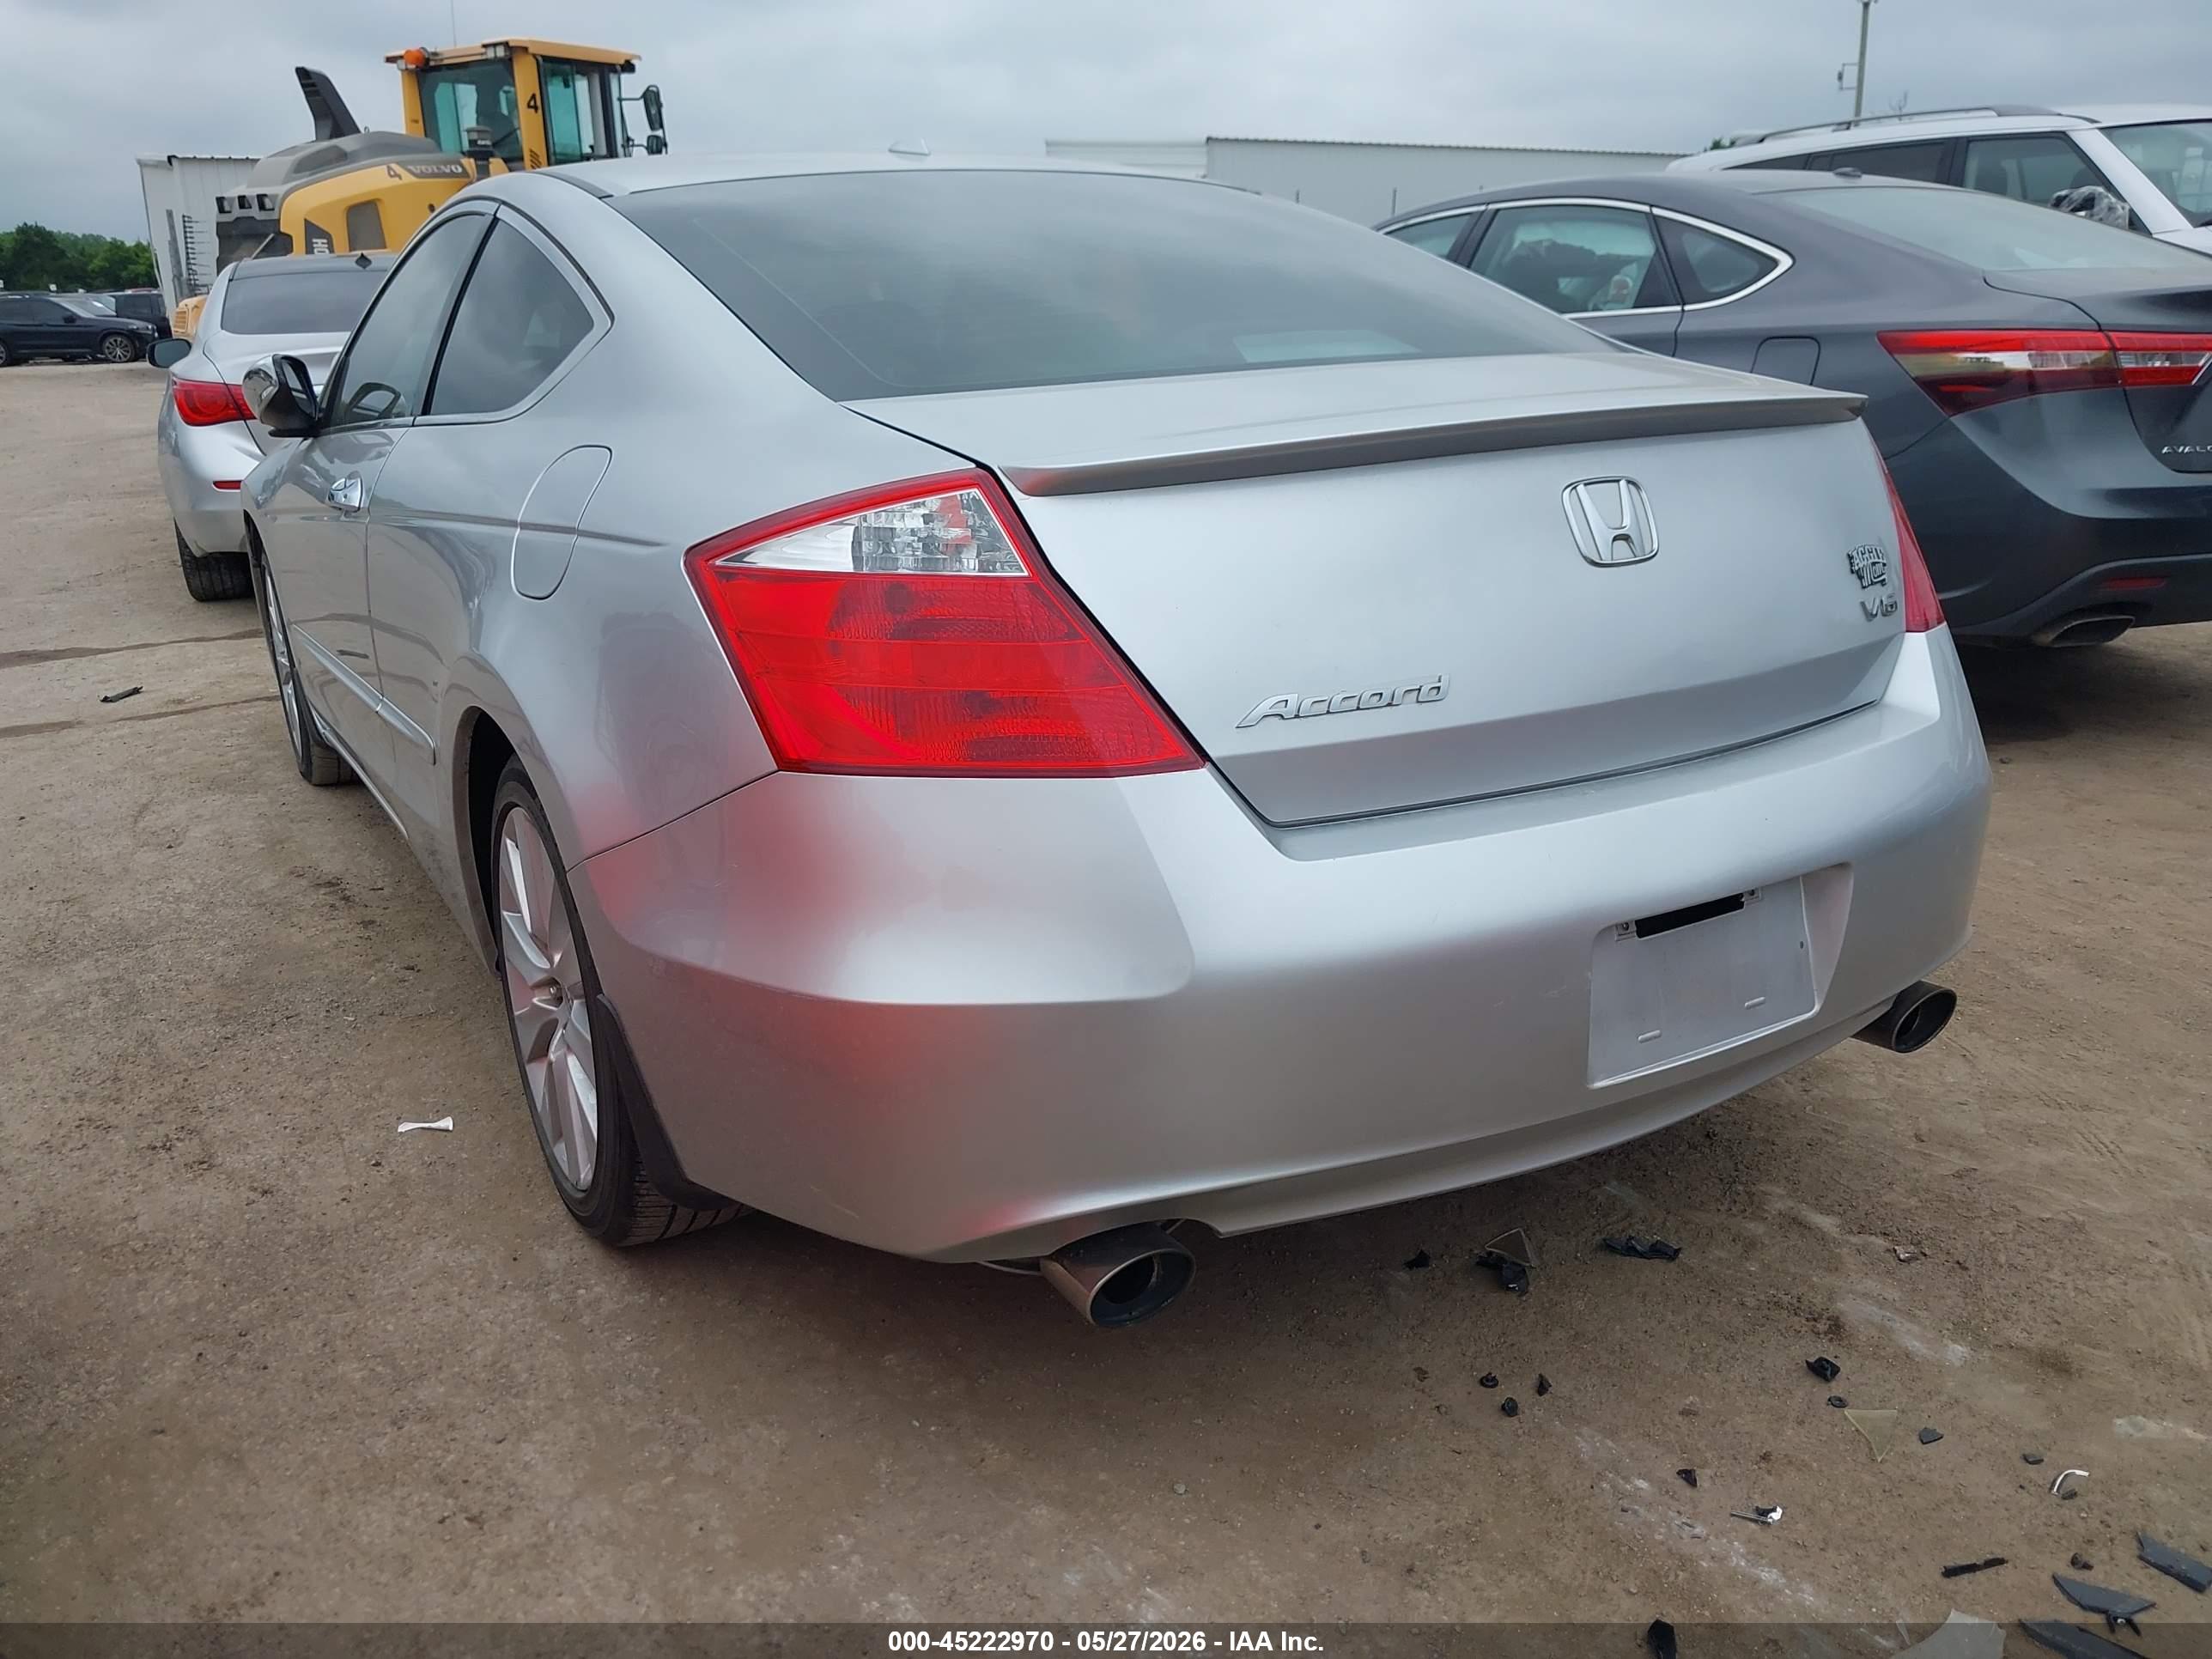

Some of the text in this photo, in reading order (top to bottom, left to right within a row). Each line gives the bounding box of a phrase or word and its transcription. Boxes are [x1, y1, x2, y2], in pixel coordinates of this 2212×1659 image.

[526, 93, 539, 113] 4
[386, 164, 403, 180] 4
[407, 164, 463, 173] VOLVO
[1860, 592, 1898, 622] V6
[1235, 674, 1449, 728] Accord
